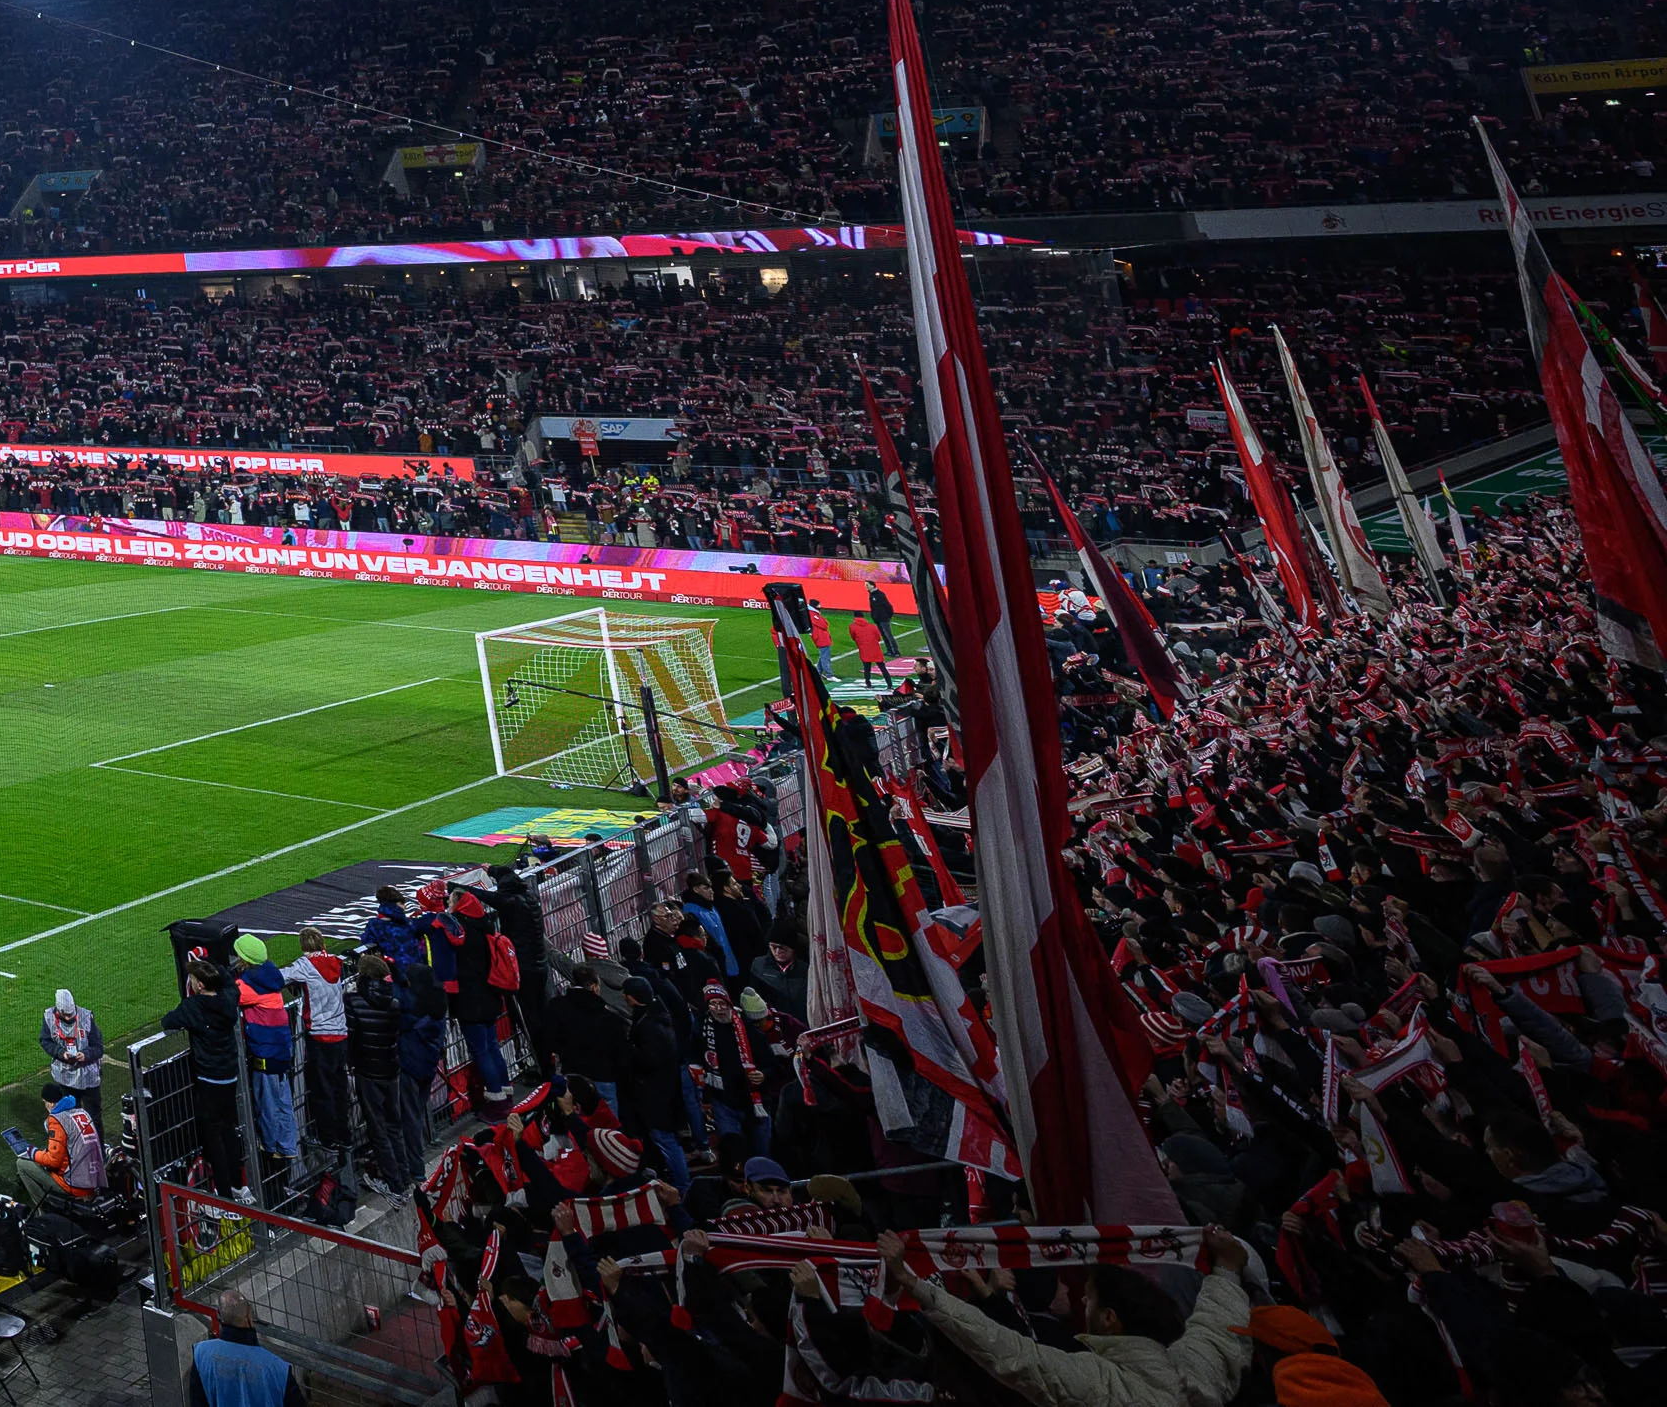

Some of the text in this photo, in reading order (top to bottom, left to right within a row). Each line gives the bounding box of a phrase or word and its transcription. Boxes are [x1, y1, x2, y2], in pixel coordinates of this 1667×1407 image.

[1535, 65, 1667, 84] Köln Bonn Airpor
[16, 260, 60, 274] FÜER
[600, 423, 624, 434] SAP
[41, 449, 77, 462] DR
[78, 451, 107, 463] HE
[234, 456, 269, 469] OP
[270, 457, 324, 472] IEHR
[49, 549, 77, 560] DERTOUR
[95, 552, 124, 563] DERTOUR
[36, 533, 117, 553] ODER
[119, 539, 182, 560] LEID,
[184, 543, 308, 566] ZOKUNF
[310, 551, 360, 570] UN
[360, 554, 666, 591] VERJANGENHEJT
[143, 556, 173, 567] DERTOUR
[245, 563, 277, 575] DERTOUR
[299, 567, 333, 579] DERTOUR
[355, 571, 391, 583] DERTOUR
[413, 575, 449, 587] DERTOUR
[473, 579, 511, 592] DERTOUR
[536, 583, 575, 596] DERTOUR
[601, 588, 643, 600] DERTOUR
[670, 593, 714, 606] DERTOUR
[736, 823, 751, 848] 9
